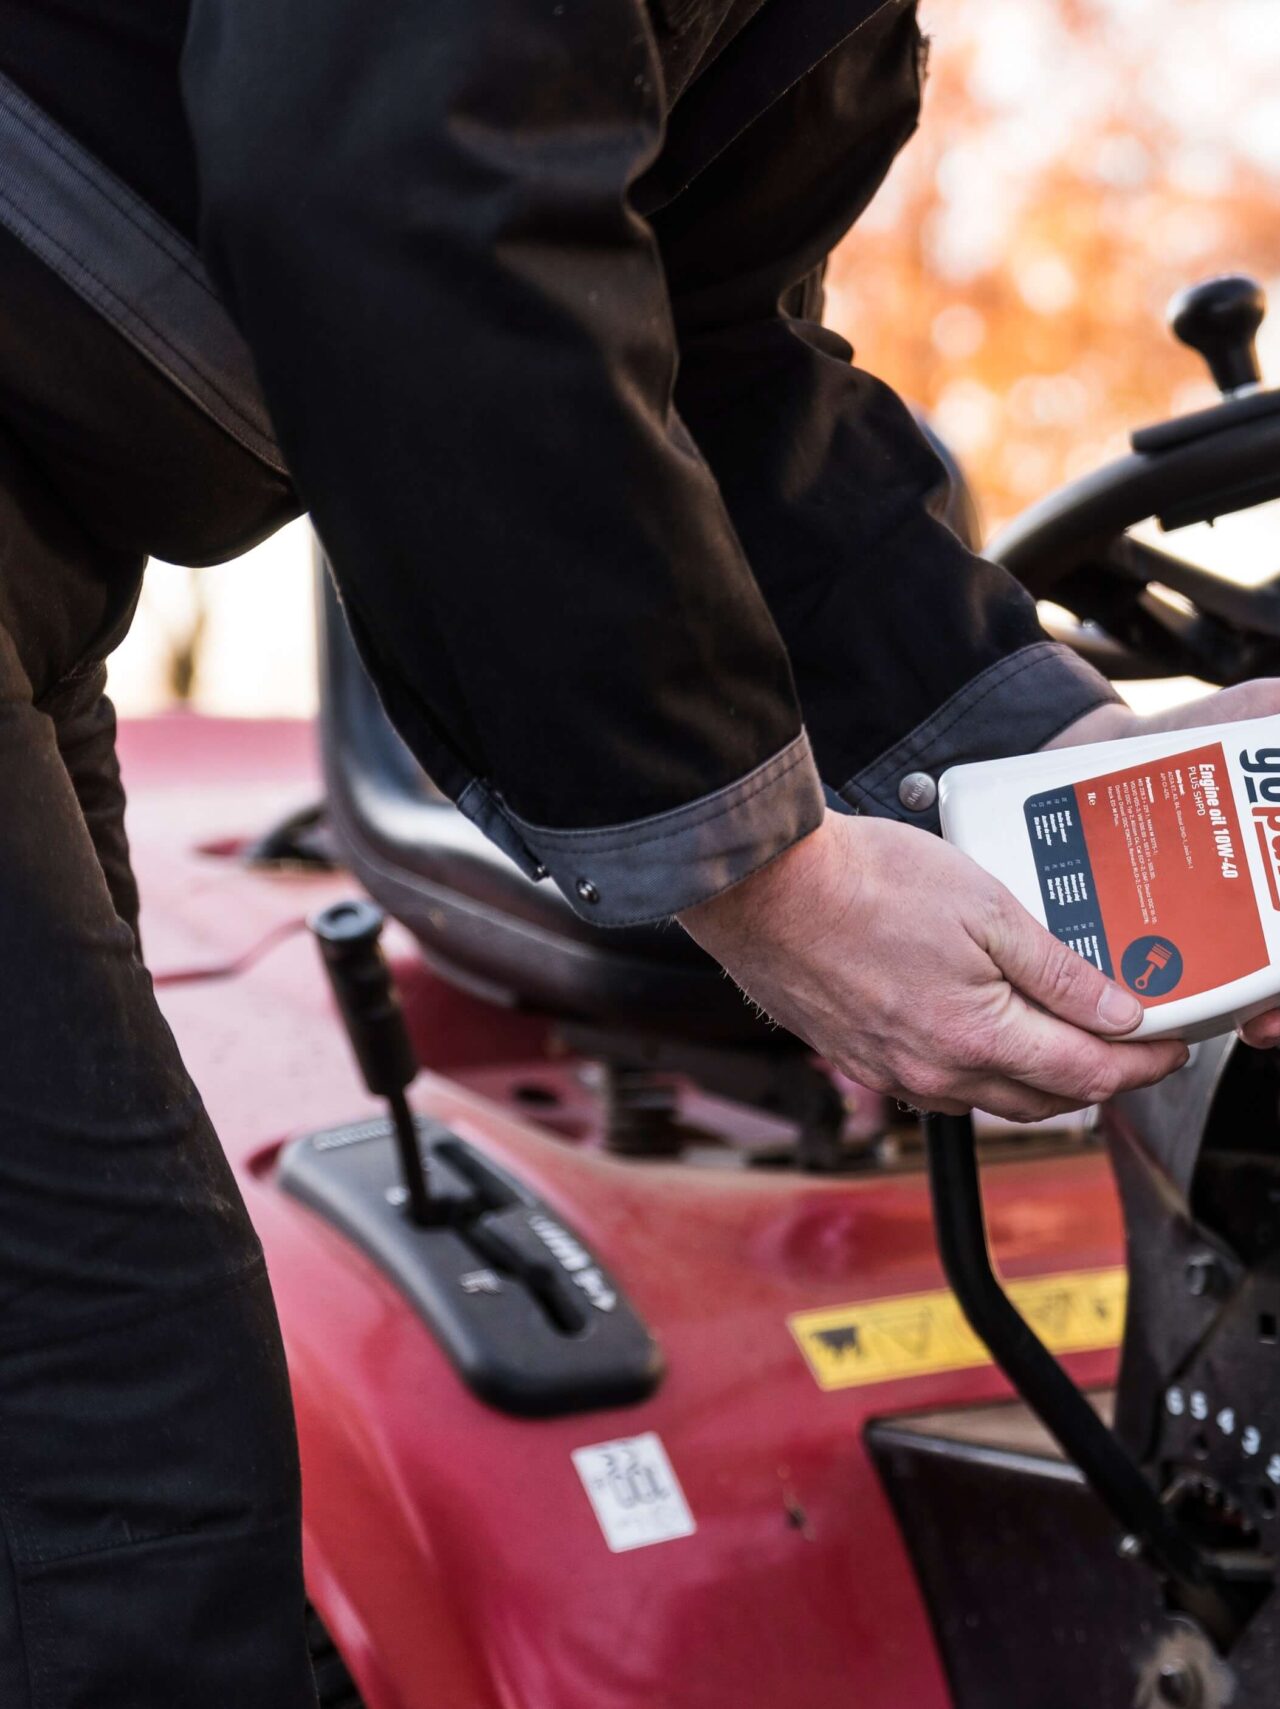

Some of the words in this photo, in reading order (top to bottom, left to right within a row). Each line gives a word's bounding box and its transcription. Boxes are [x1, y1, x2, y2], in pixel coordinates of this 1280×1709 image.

[1130, 780, 1138, 796] VOLVO
[1187, 765, 1200, 790] PLUS
[1198, 763, 1220, 810] Engine
[1193, 790, 1206, 816] SHPD
[1208, 808, 1227, 826] oil
[1213, 828, 1239, 878] 10W-40
[1165, 1385, 1186, 1417] 6
[1190, 1390, 1209, 1421] 5
[1216, 1406, 1236, 1436] 4
[1241, 1424, 1262, 1457] 3
